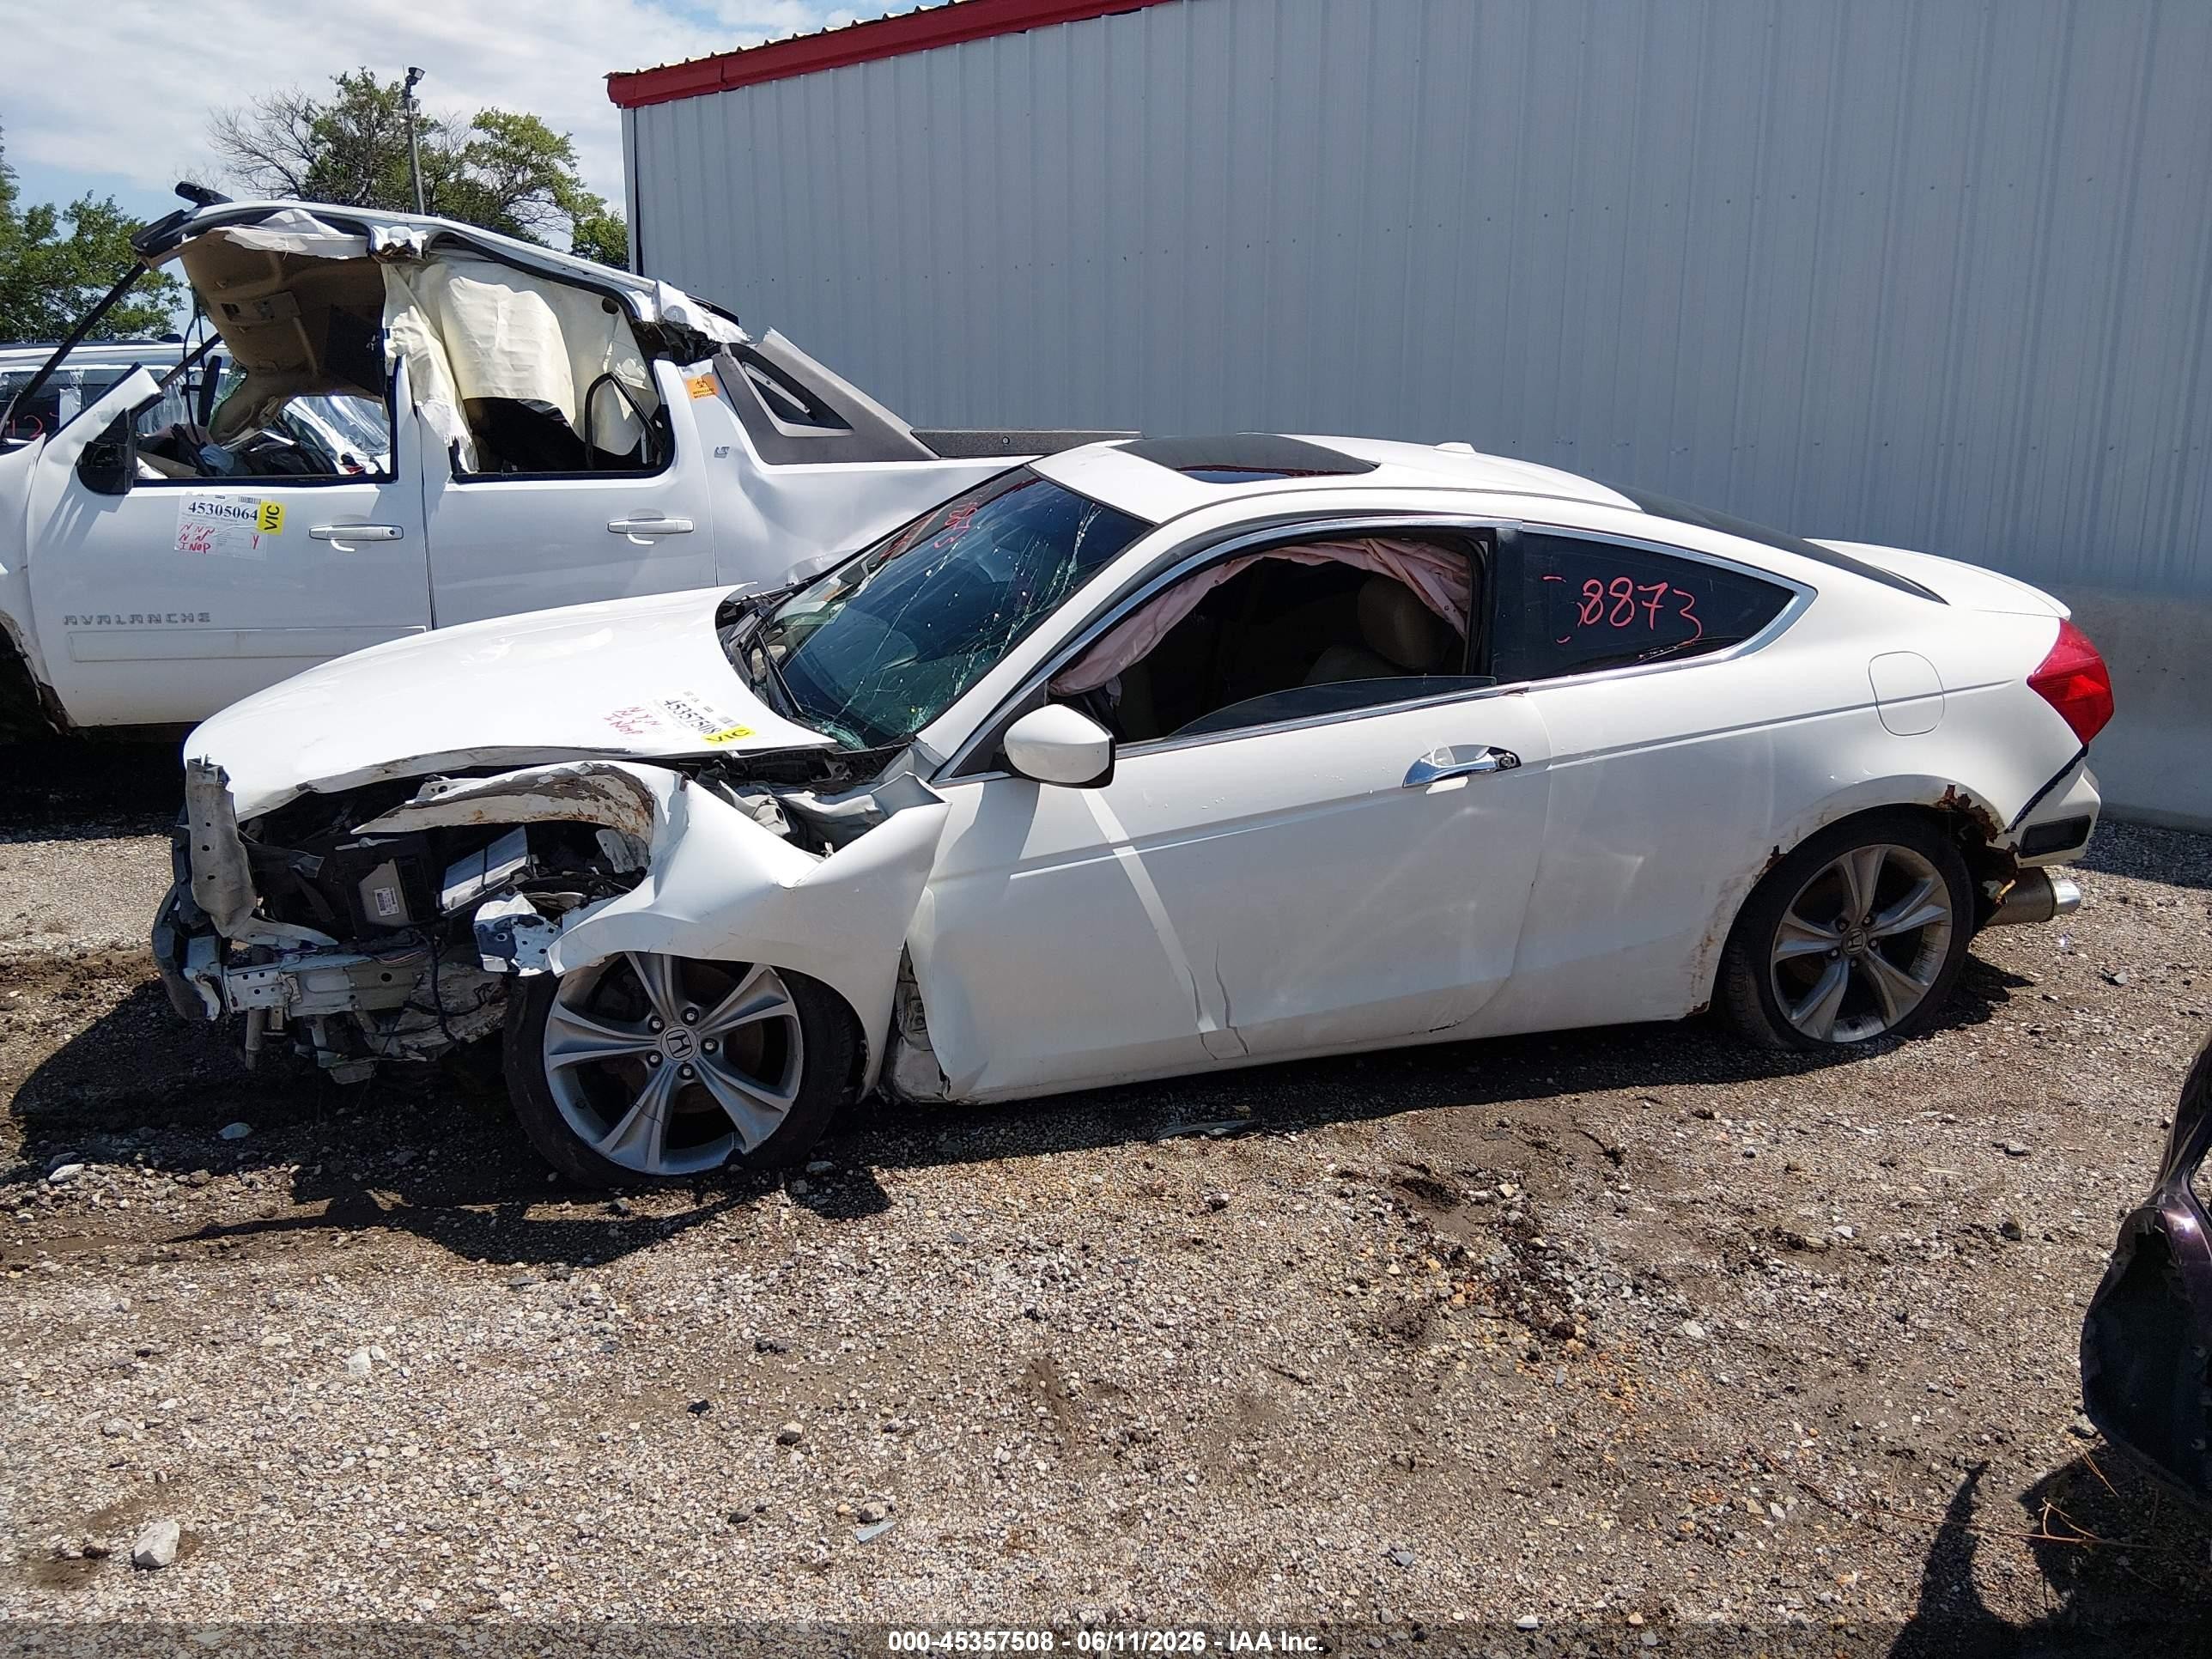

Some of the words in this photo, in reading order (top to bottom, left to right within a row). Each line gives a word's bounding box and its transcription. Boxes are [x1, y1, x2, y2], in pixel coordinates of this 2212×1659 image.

[188, 501, 258, 521] 45305064
[264, 505, 280, 531] VIC
[64, 611, 211, 626] AVALANCHE
[664, 700, 722, 734] 45357508
[705, 729, 750, 743] VIC
